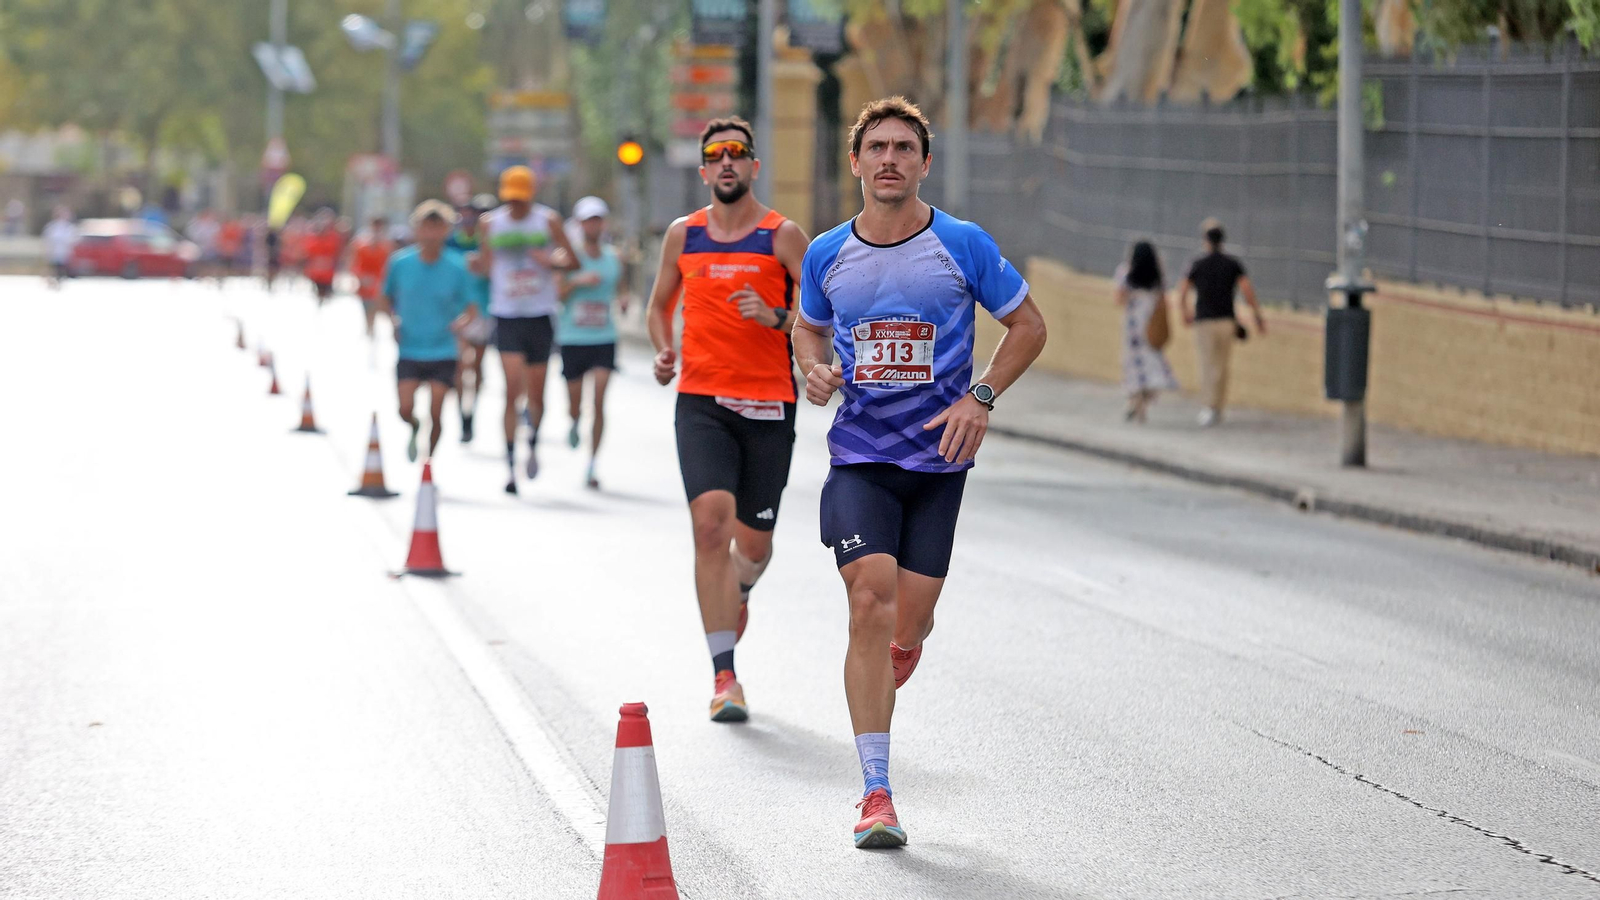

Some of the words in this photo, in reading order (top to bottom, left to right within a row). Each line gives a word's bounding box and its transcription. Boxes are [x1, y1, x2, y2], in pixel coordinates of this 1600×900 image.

[875, 330, 895, 338] XXIX
[871, 342, 914, 363] 313
[879, 369, 927, 379] MIZUNO
